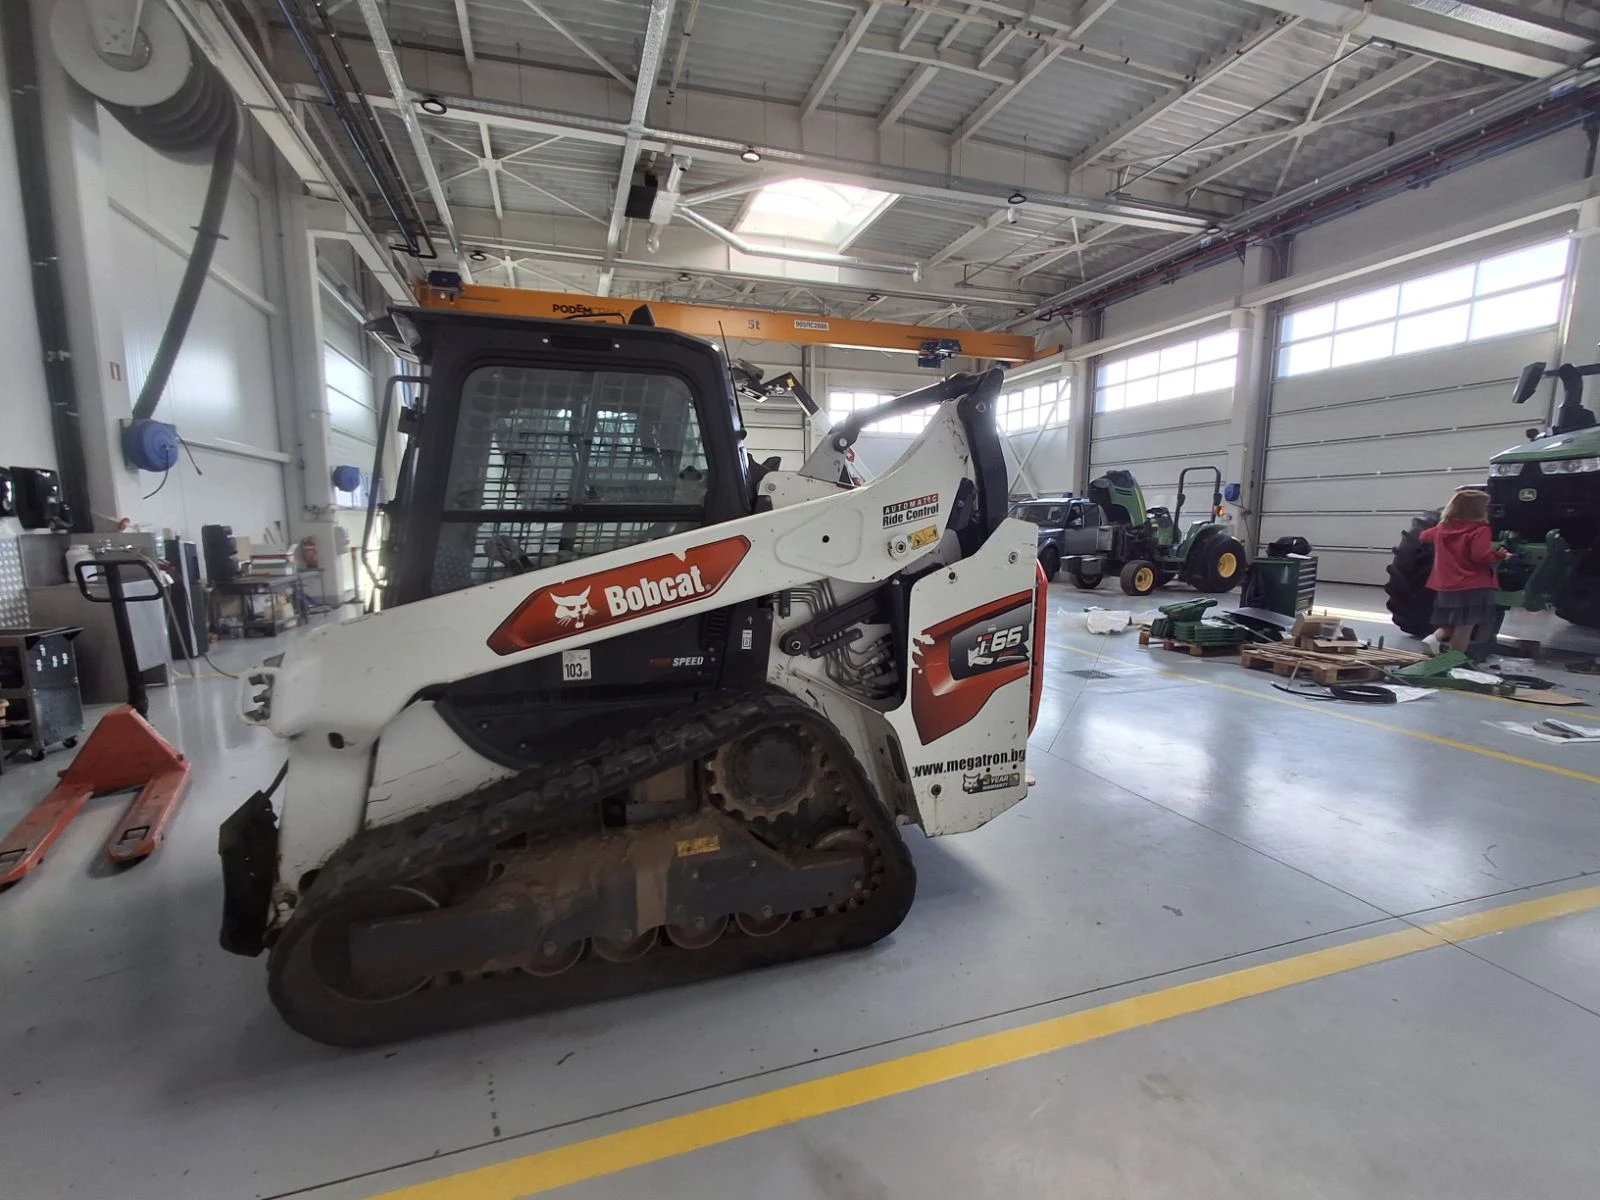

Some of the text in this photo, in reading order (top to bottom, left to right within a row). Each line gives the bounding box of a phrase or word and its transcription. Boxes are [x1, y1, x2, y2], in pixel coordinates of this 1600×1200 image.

[883, 503, 939, 527] Ride Control
[884, 494, 938, 514] AUTOMATIC
[604, 565, 705, 617] Bobcat
[976, 625, 1024, 656] T66
[564, 663, 583, 678] 103
[672, 656, 704, 667] SPEED
[912, 748, 1026, 778] www.megatron.bg
